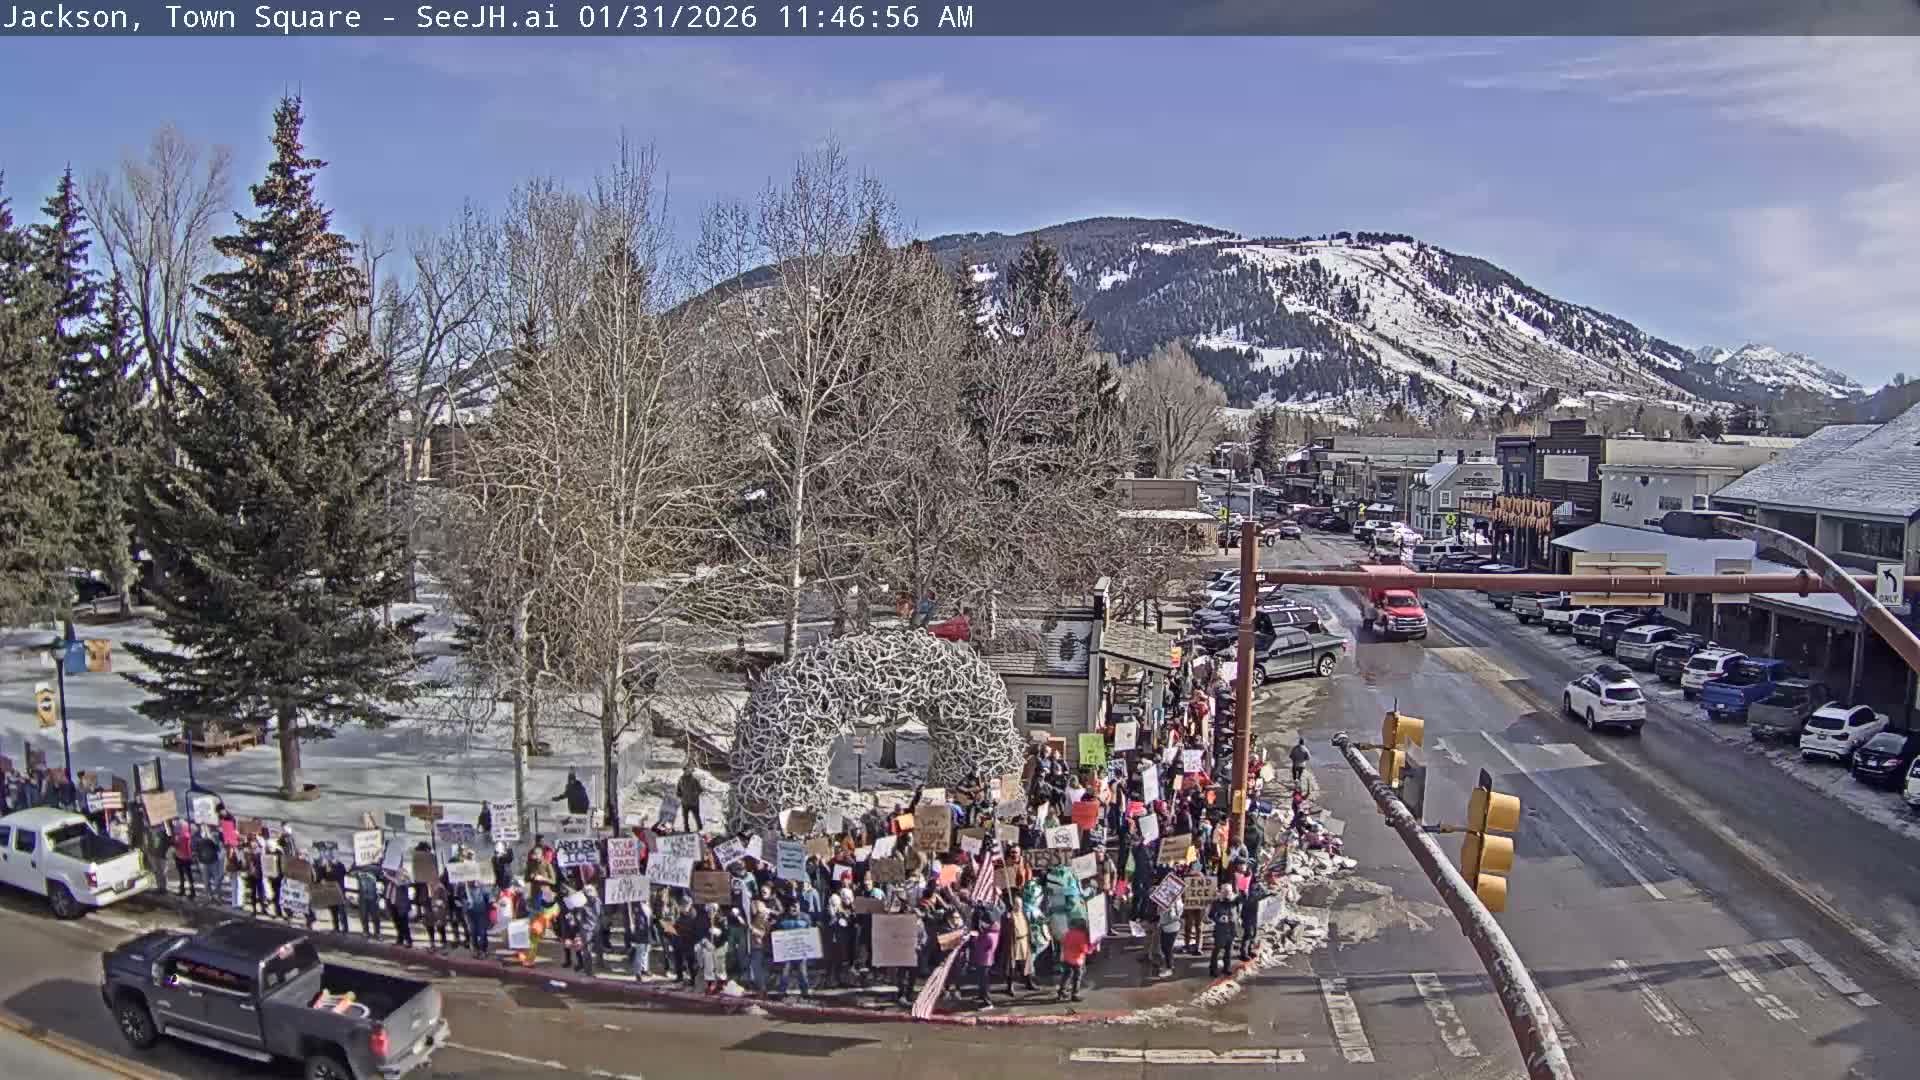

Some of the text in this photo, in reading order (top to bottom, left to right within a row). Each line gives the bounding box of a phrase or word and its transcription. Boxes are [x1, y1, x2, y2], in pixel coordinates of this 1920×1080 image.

[1878, 594, 1899, 603] ONLY
[611, 840, 634, 849] YOUR
[564, 851, 596, 864] ICE
[1024, 850, 1070, 867] RESIST
[1190, 879, 1212, 887] END
[1191, 889, 1209, 897] ICE
